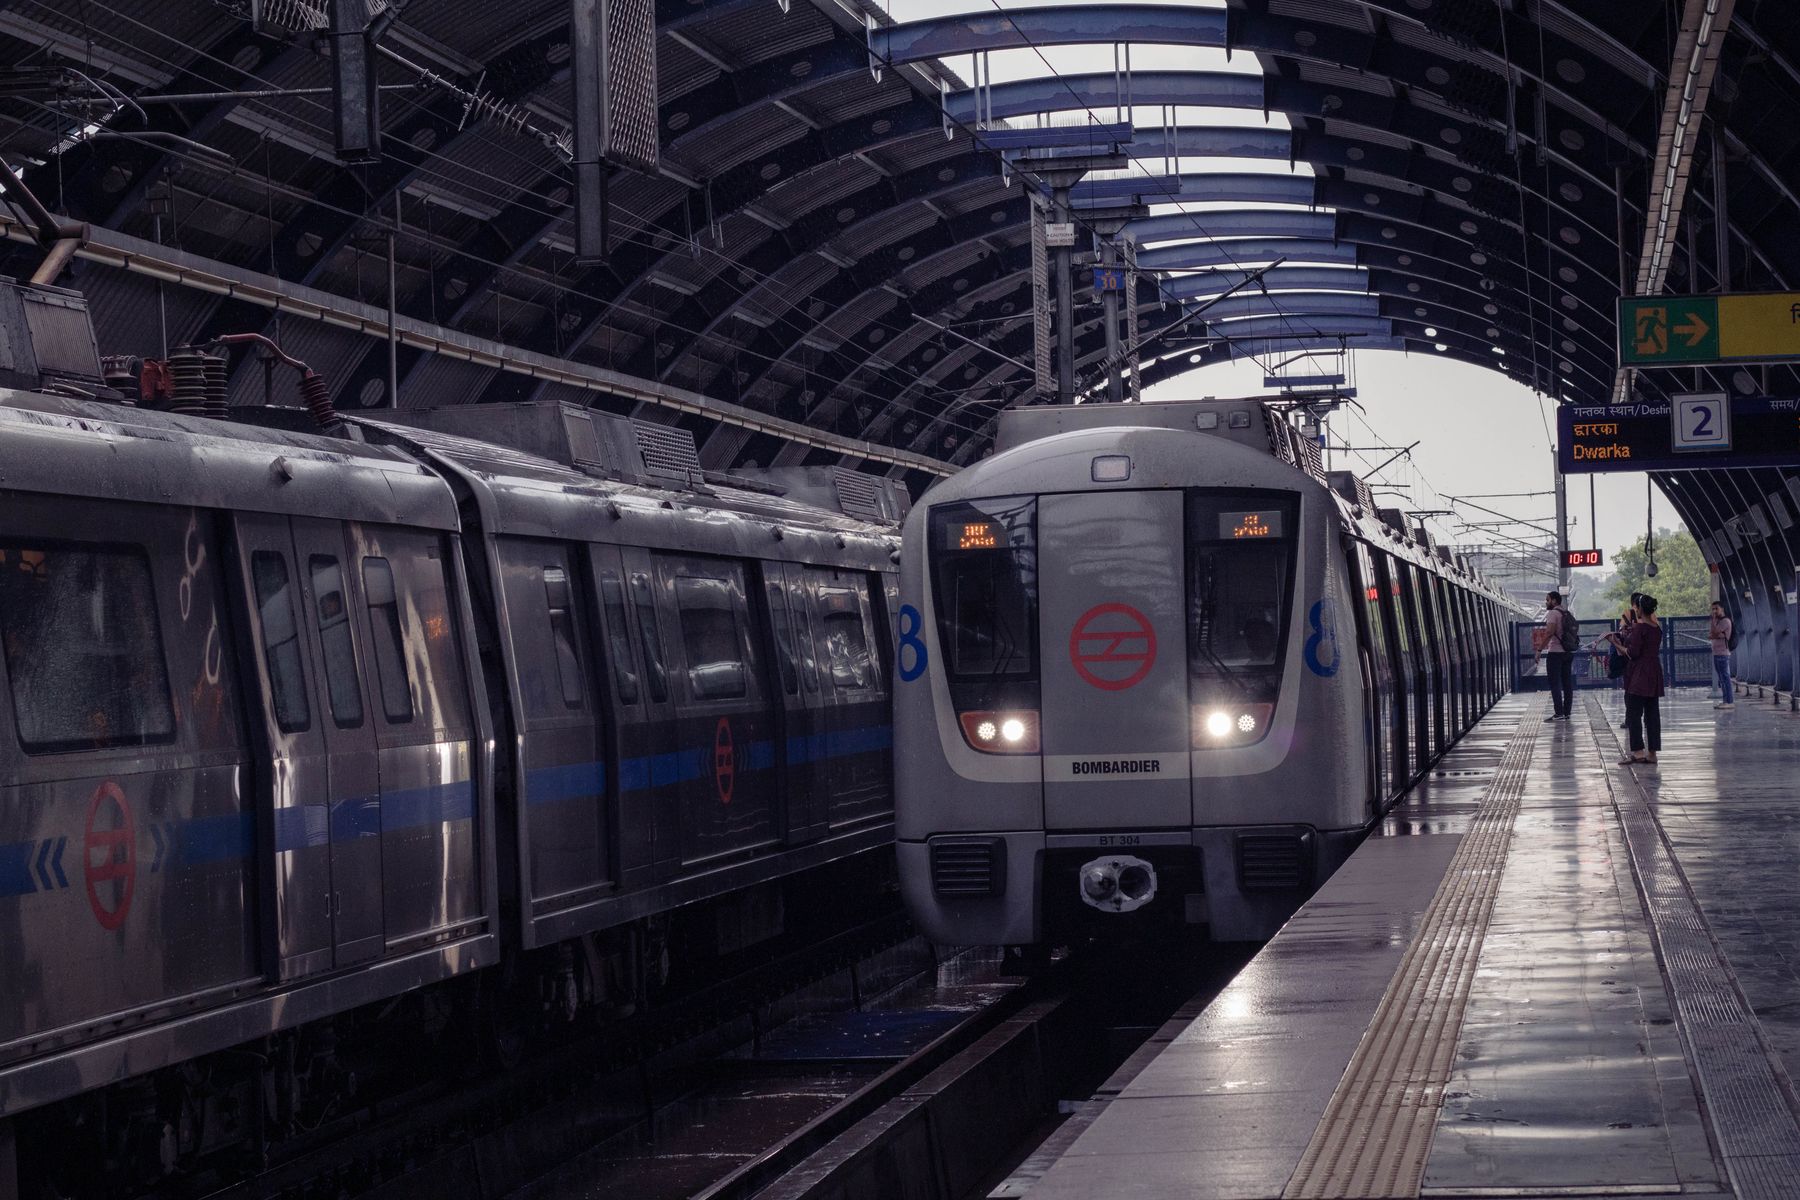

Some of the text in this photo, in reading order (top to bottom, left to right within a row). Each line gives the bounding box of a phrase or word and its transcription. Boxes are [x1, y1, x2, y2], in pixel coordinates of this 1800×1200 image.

[1573, 407, 1606, 417] गन्तव्य
[1691, 406, 1713, 437] 2
[1573, 423, 1619, 437] द्वारका
[1573, 443, 1631, 460] Dwarka
[898, 604, 928, 682] 8
[1072, 760, 1160, 774] BOMBARDIER
[1099, 835, 1140, 846] BT 304
